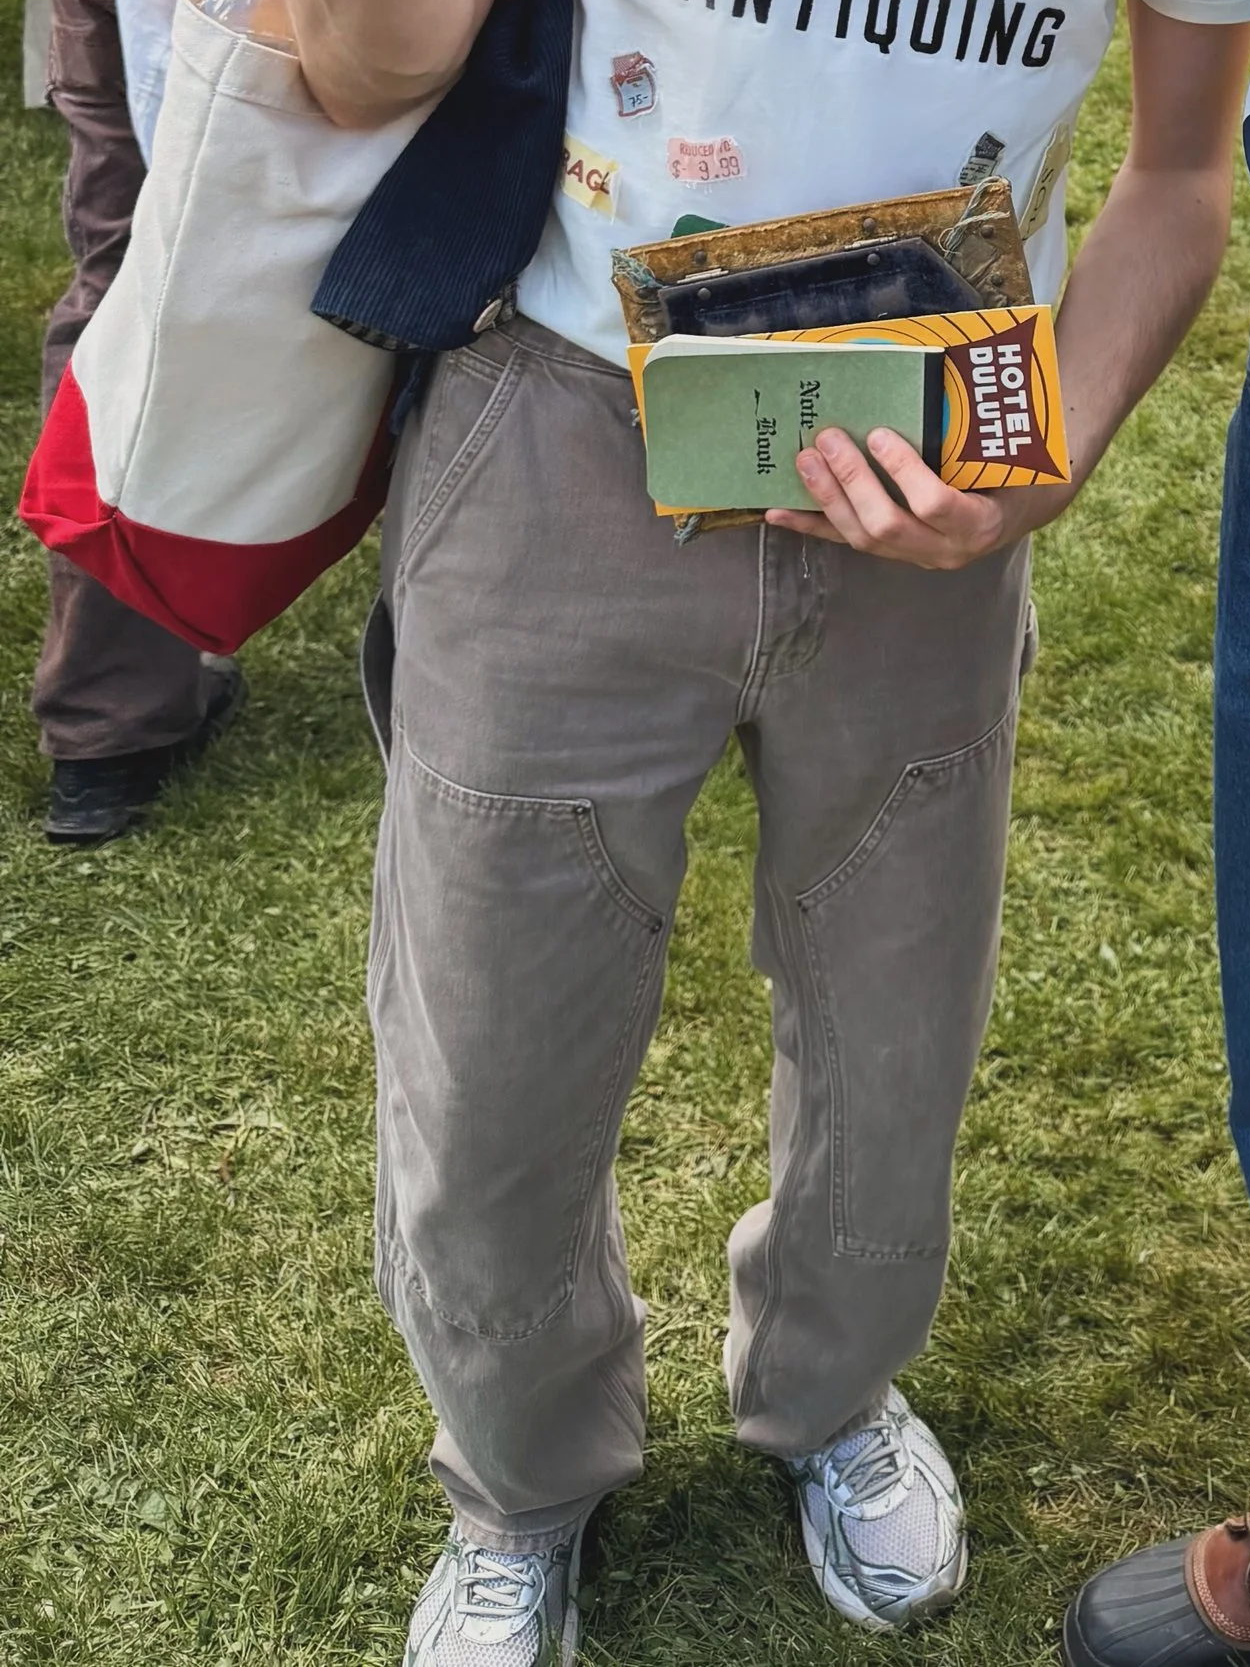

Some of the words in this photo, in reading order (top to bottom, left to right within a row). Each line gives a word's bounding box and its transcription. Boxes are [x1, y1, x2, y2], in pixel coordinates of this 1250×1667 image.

[799, 379, 821, 431] Note
[968, 346, 1006, 458] DULUTH
[997, 343, 1033, 456] HOTEL
[755, 416, 777, 476] Book
